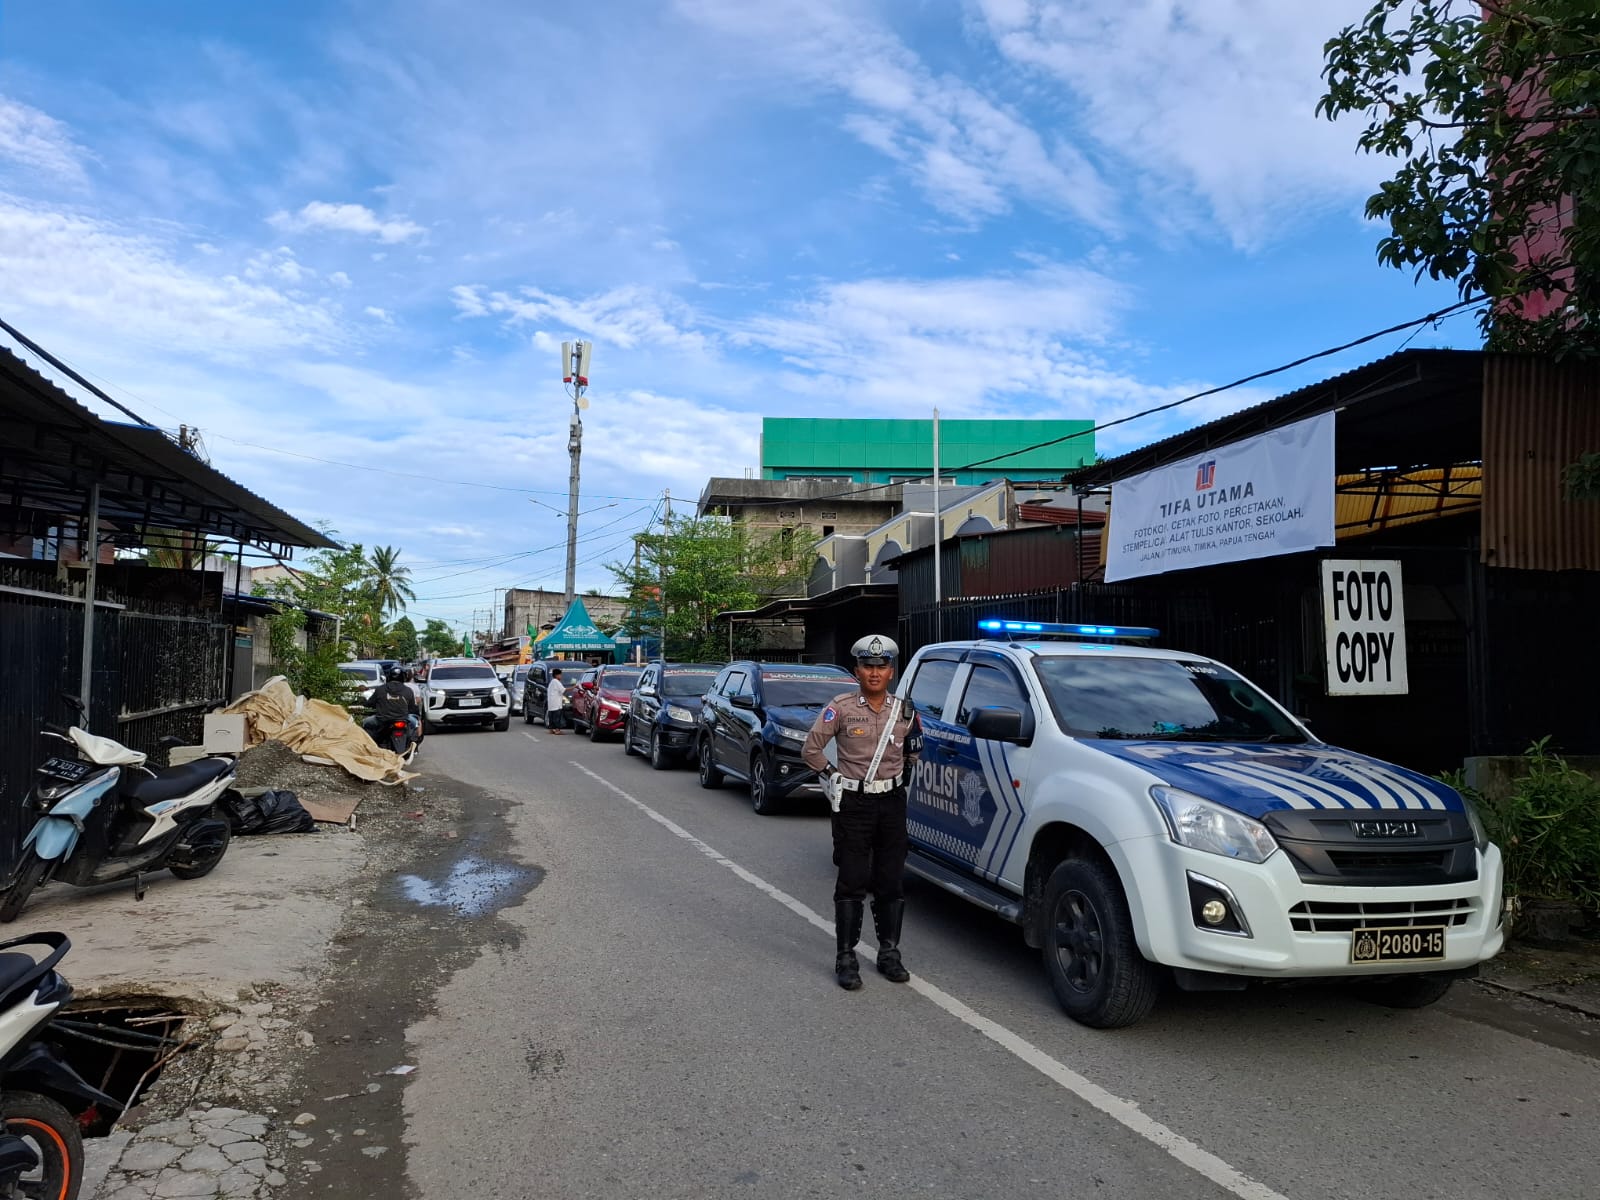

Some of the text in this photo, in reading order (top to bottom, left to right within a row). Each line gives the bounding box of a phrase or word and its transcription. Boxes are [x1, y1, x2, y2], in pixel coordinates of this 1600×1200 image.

[1160, 481, 1254, 518] TIFA UTAMA
[1169, 530, 1190, 543] ALAT
[1191, 526, 1214, 539] TULIS
[1171, 517, 1196, 530] CETAK
[1140, 551, 1160, 562] JALAN
[1244, 530, 1275, 542] TENGAH
[1332, 570, 1393, 621] FOTO
[1336, 631, 1395, 683] COPY
[916, 759, 958, 800] POLISI
[916, 789, 959, 816] LALU LINTAS
[1355, 822, 1417, 836] ISUZU
[1381, 933, 1442, 954] 2080-15
